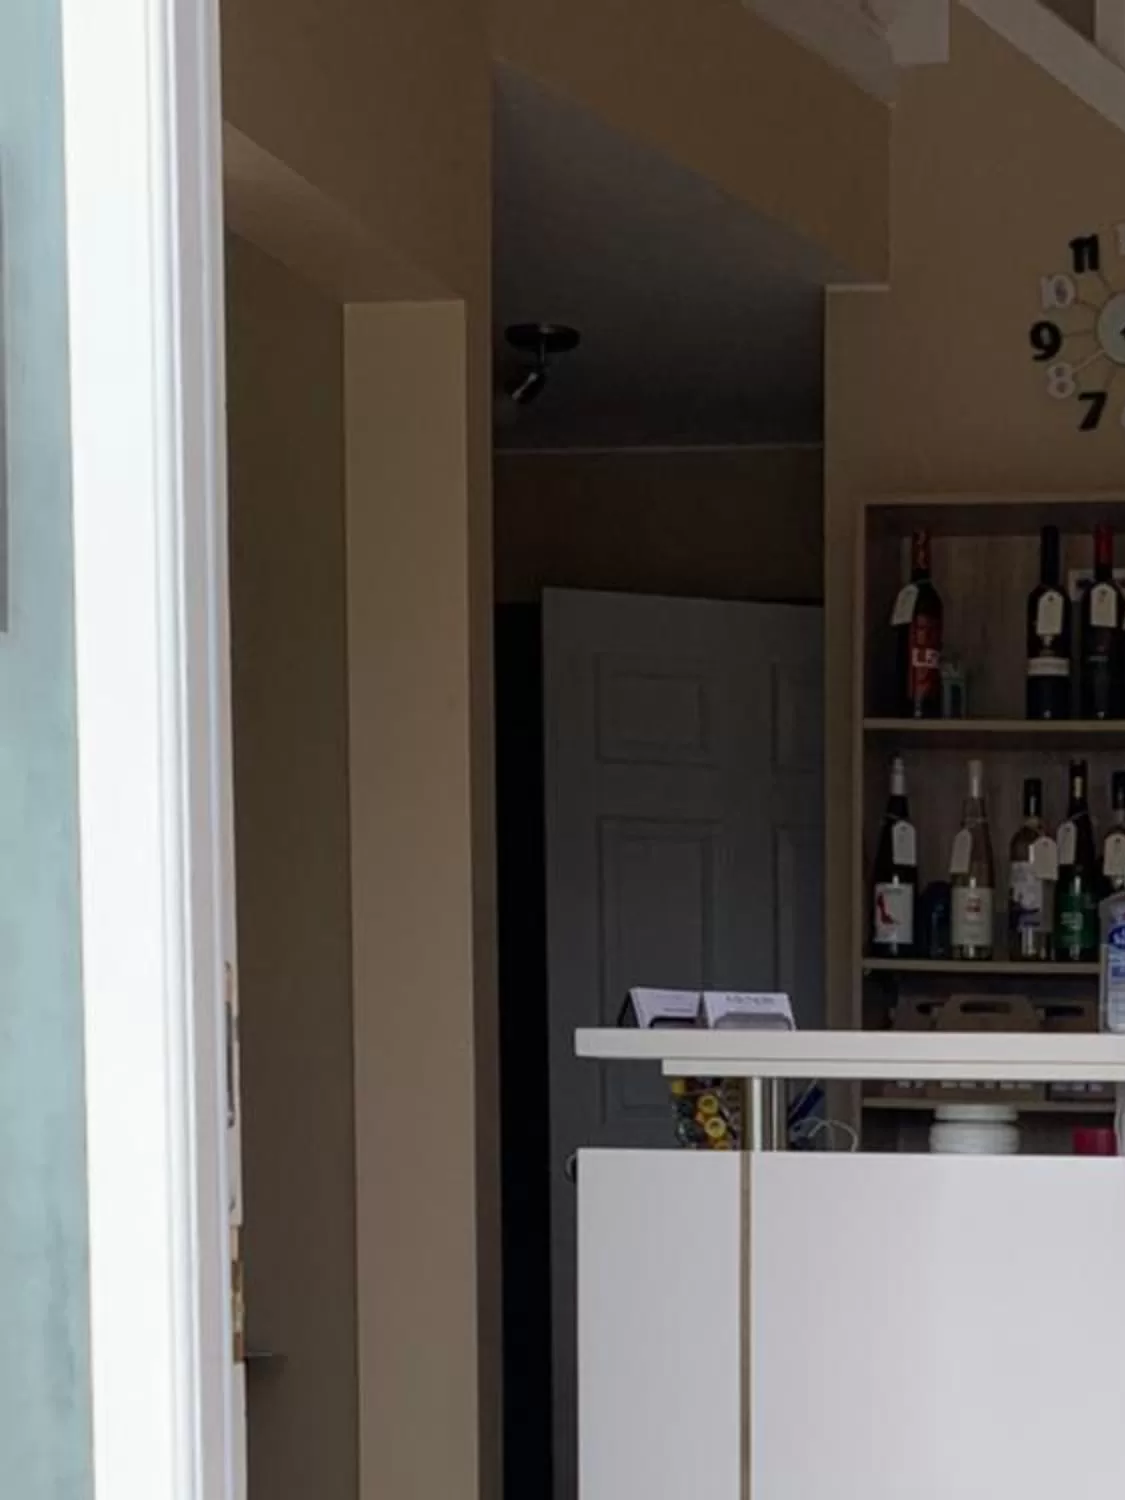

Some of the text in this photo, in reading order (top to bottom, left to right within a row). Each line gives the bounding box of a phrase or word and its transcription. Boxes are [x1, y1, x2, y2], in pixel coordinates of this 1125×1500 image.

[1069, 234, 1099, 272] 11
[1041, 275, 1075, 308] 10
[1030, 321, 1062, 360] 9
[1048, 363, 1074, 398] 8
[1078, 392, 1107, 430] 7
